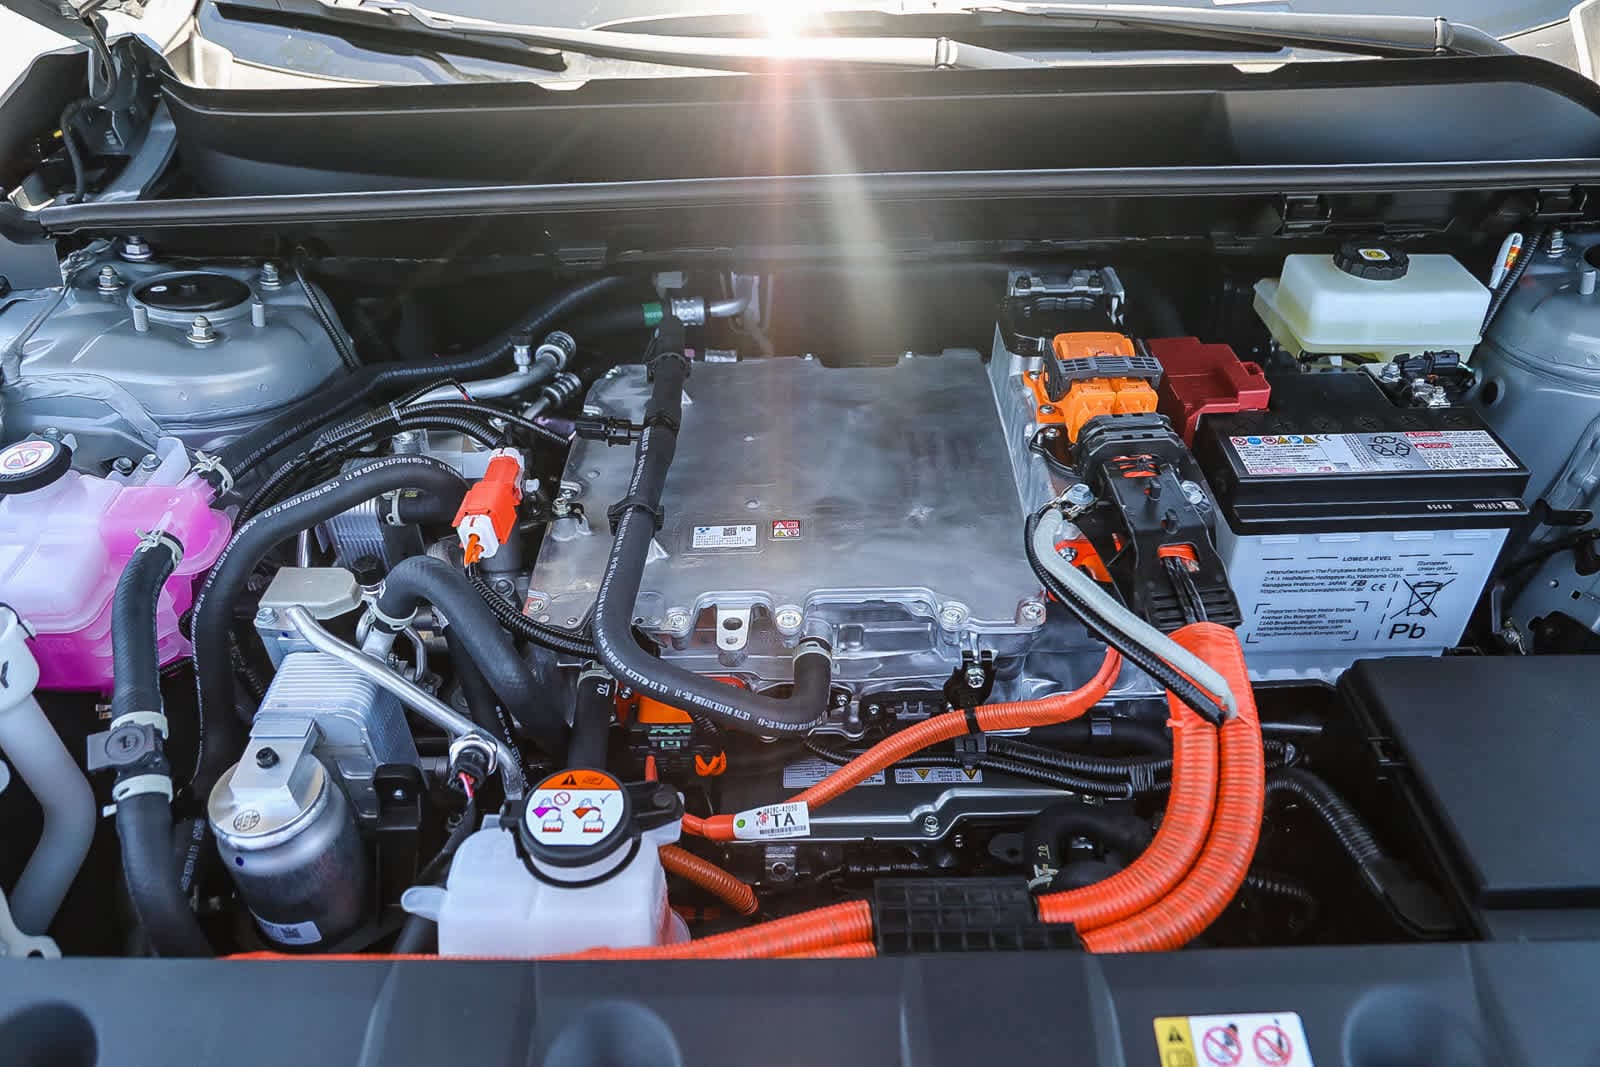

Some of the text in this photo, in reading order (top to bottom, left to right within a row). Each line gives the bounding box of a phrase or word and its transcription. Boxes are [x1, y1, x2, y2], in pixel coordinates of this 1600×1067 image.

[1371, 583, 1386, 592] CE
[1388, 622, 1426, 639] Pb
[770, 812, 795, 827] TA
